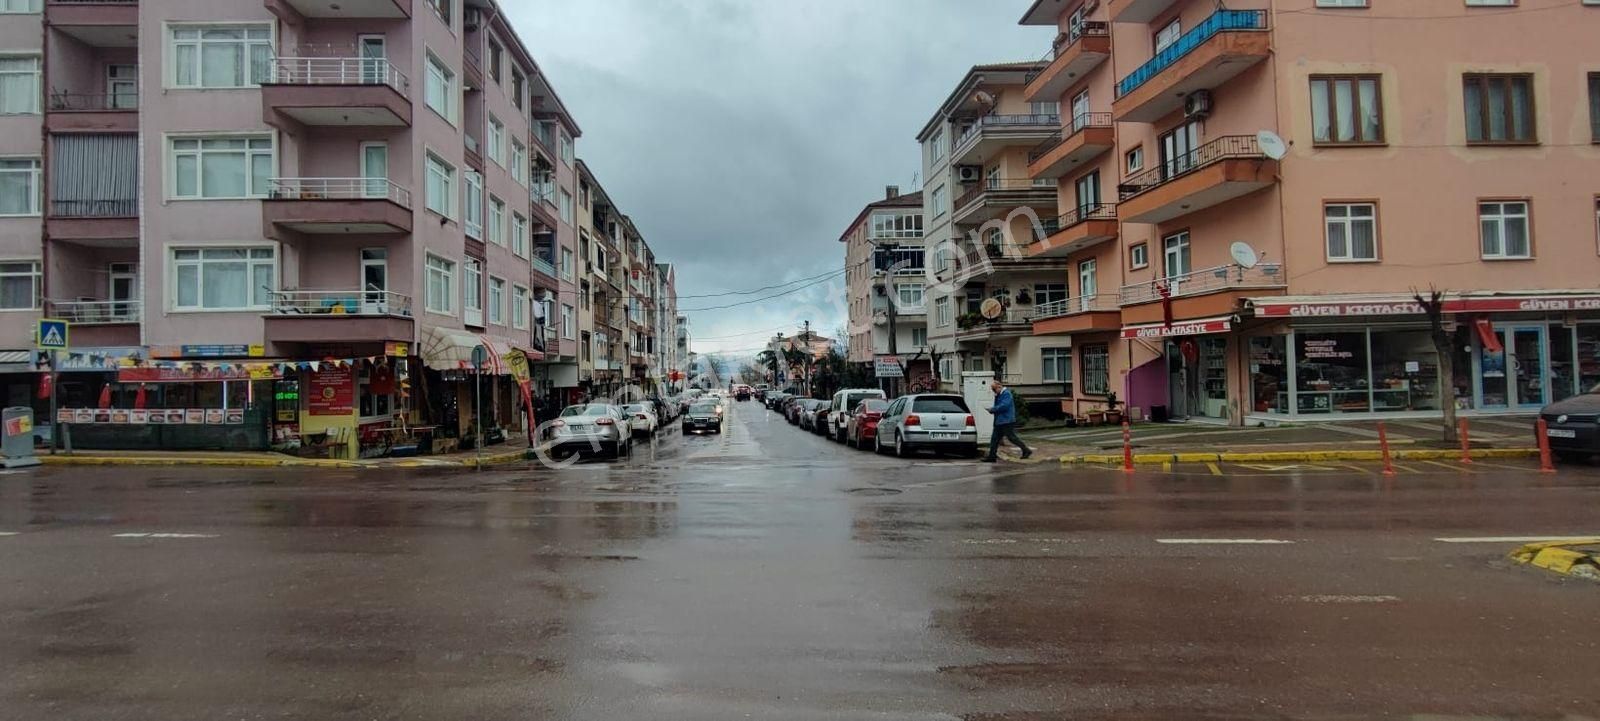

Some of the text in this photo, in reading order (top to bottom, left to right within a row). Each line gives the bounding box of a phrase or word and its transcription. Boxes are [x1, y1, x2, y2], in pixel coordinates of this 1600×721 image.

[1289, 304, 1340, 316] GÜVEN
[1519, 299, 1569, 310] GÜVEN
[1136, 327, 1160, 337] GÜVEN
